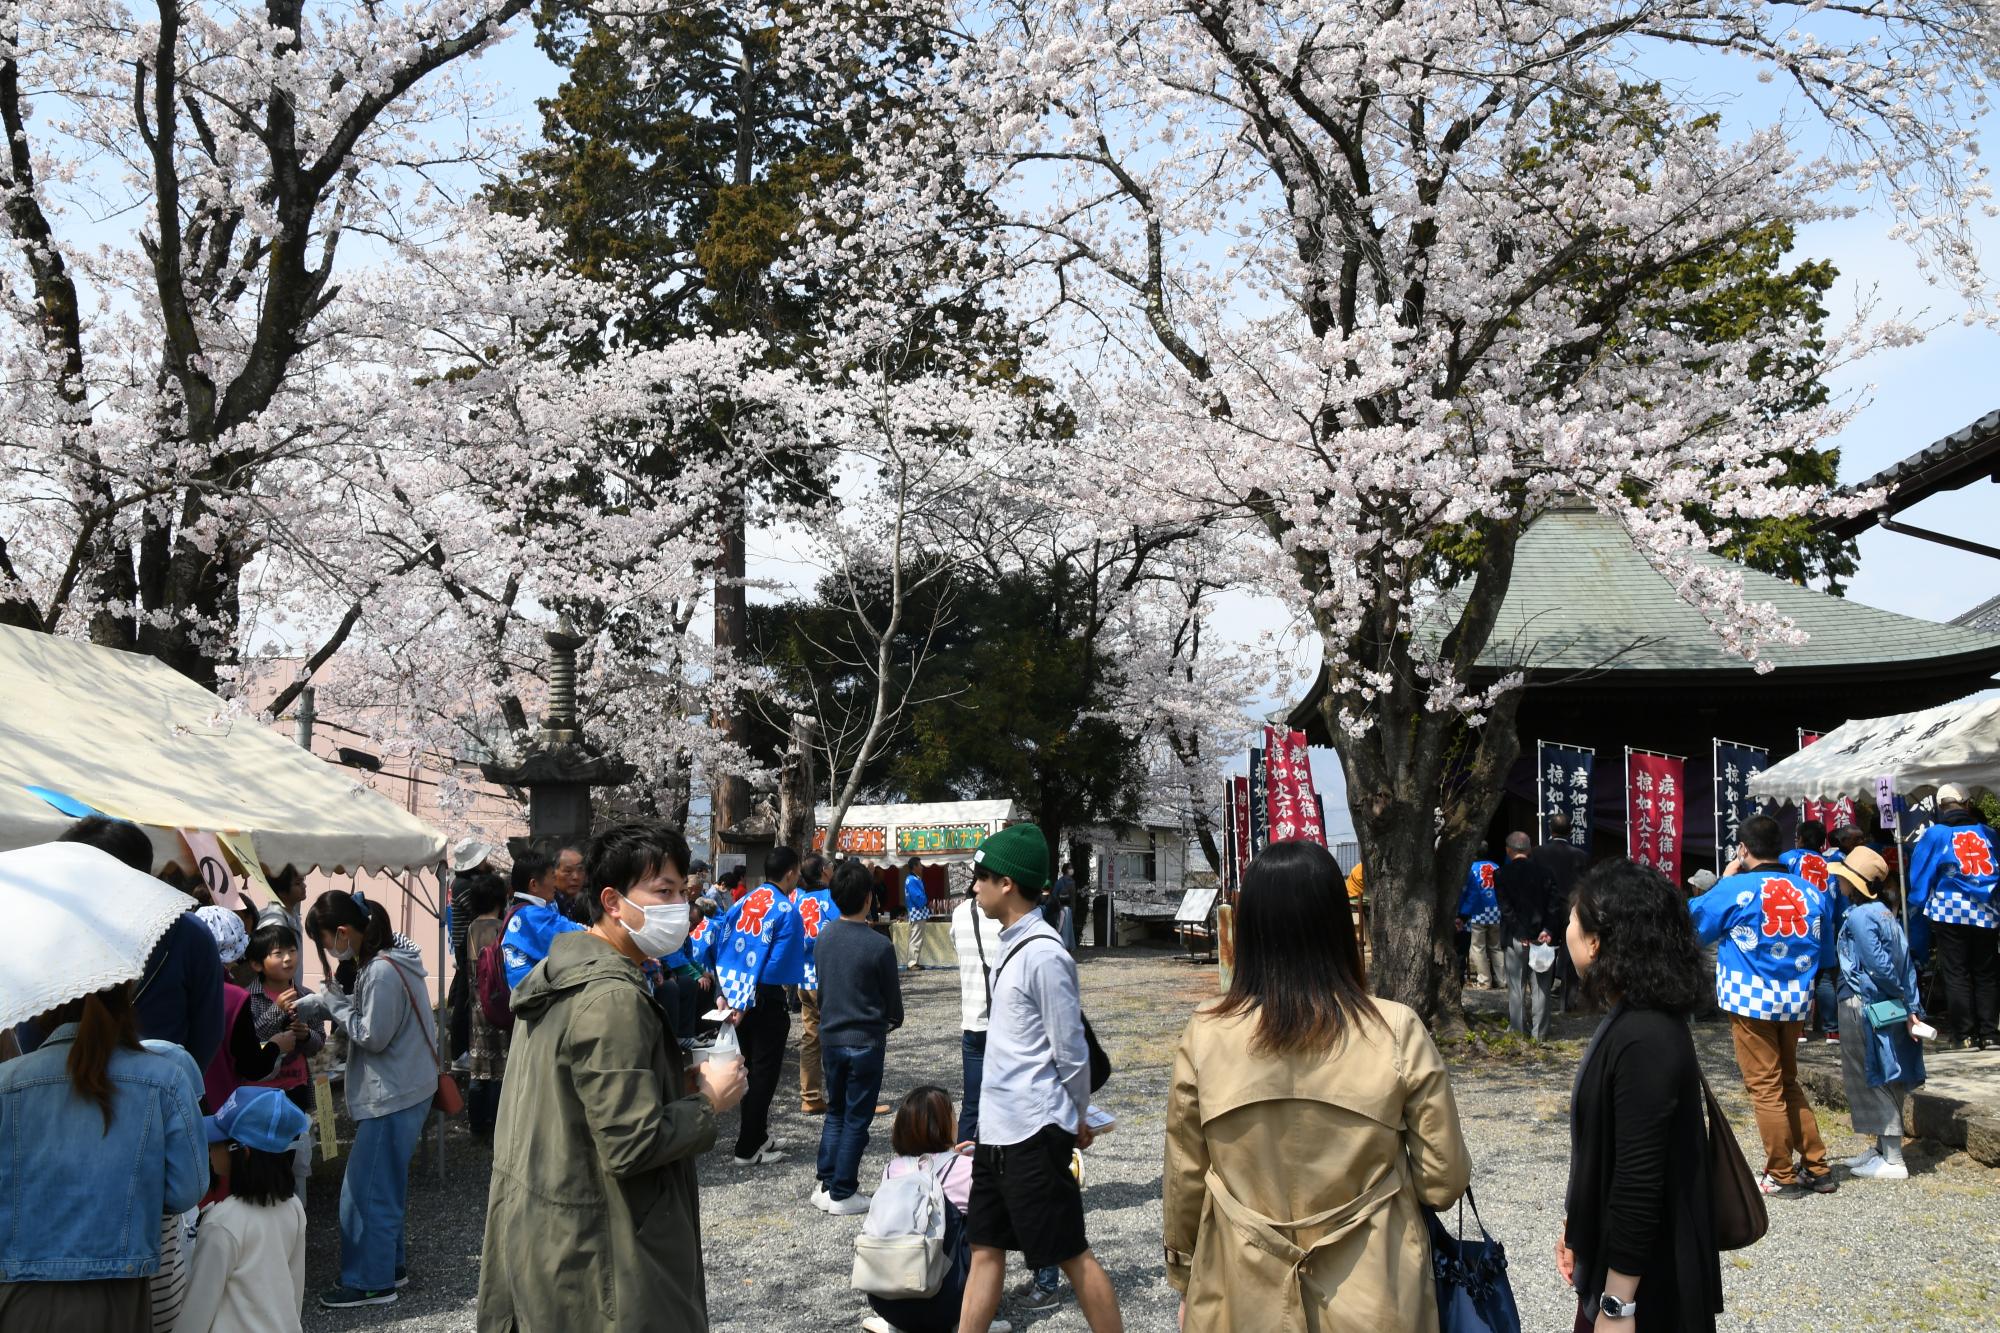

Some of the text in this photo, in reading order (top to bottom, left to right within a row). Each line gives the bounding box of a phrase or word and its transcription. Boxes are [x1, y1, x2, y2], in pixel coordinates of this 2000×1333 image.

[1290, 744, 1322, 845] 疾如風徐如
[902, 830, 983, 849] チョコバナナ
[1656, 773, 1677, 879] 疾如風徐如
[200, 856, 229, 895] の
[1952, 831, 1994, 876] 祭
[736, 886, 775, 937] 祭
[1761, 877, 1809, 938] 祭
